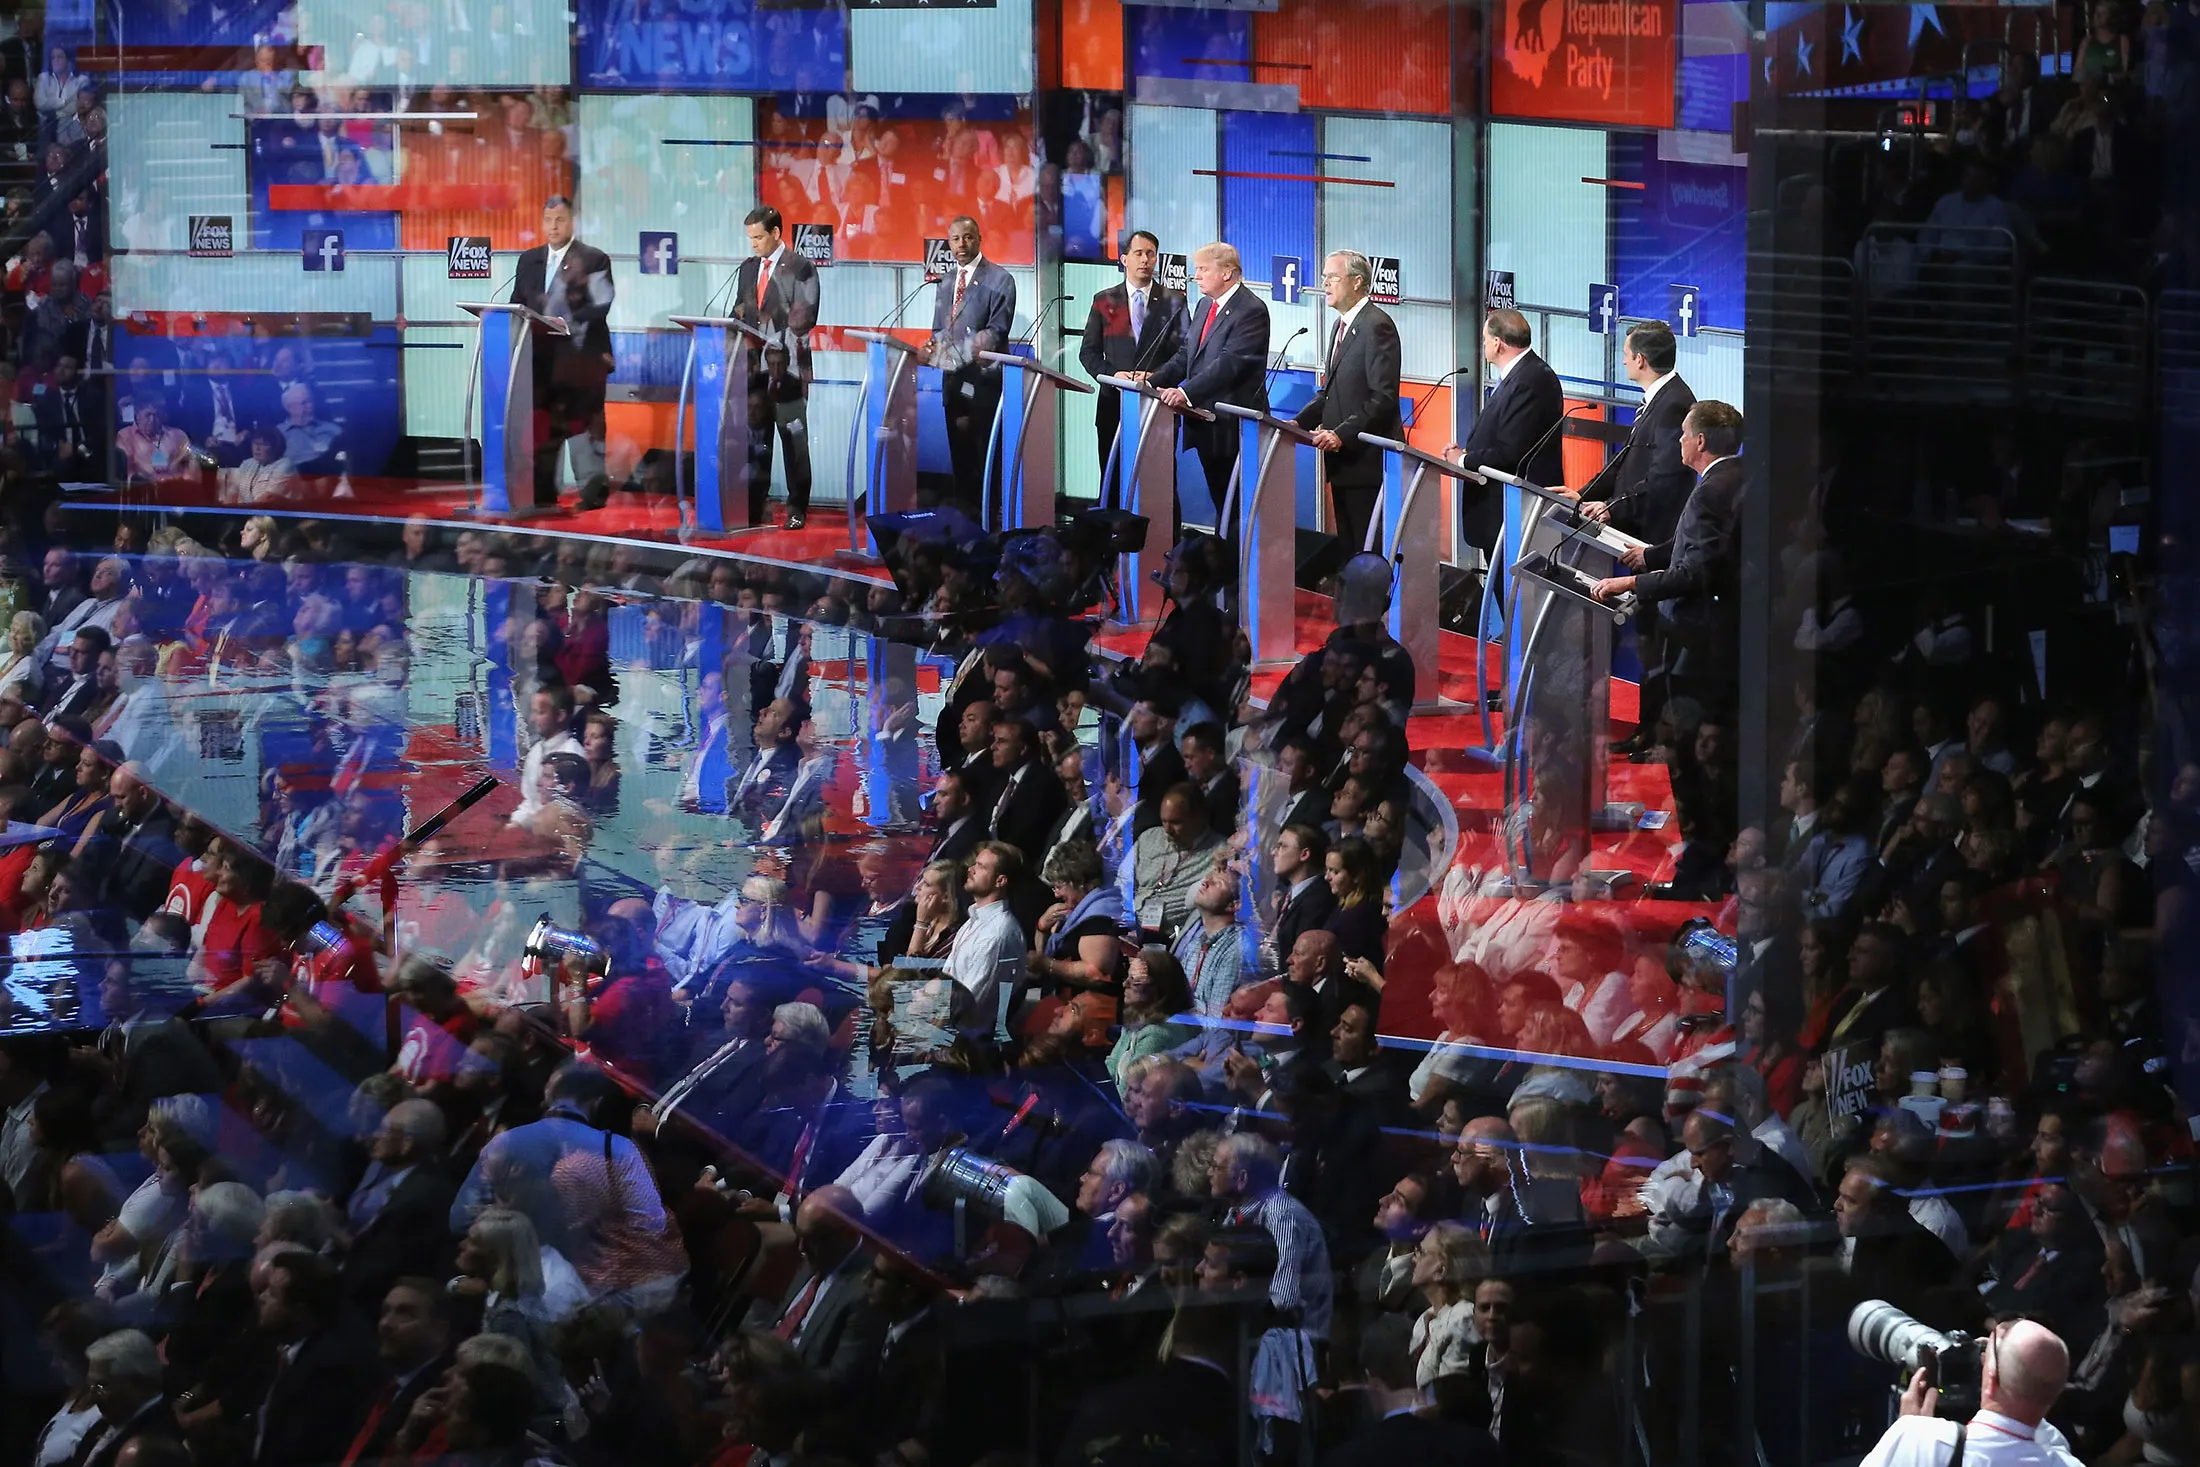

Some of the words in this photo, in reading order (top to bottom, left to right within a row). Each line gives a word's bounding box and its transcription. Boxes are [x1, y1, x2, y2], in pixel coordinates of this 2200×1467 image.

[1567, 0, 1662, 46] Republican
[619, 20, 751, 75] NEWS
[1567, 44, 1613, 100] Party
[202, 225, 230, 238] FOX
[195, 238, 231, 250] NEWS
[805, 233, 830, 247] FOX
[461, 246, 489, 259] FOX
[798, 247, 831, 259] NEWS
[937, 249, 957, 262] FO
[454, 259, 489, 270] NEWS
[930, 262, 957, 274] NEW
[1168, 264, 1186, 278] FOX
[1379, 268, 1398, 282] FOX
[1163, 277, 1187, 291] NEWS
[1373, 281, 1399, 296] NEWS
[1495, 282, 1513, 297] FOX
[1490, 296, 1513, 309] NEWS
[1842, 1061, 1875, 1091] FOX
[1834, 1085, 1874, 1117] NEW
